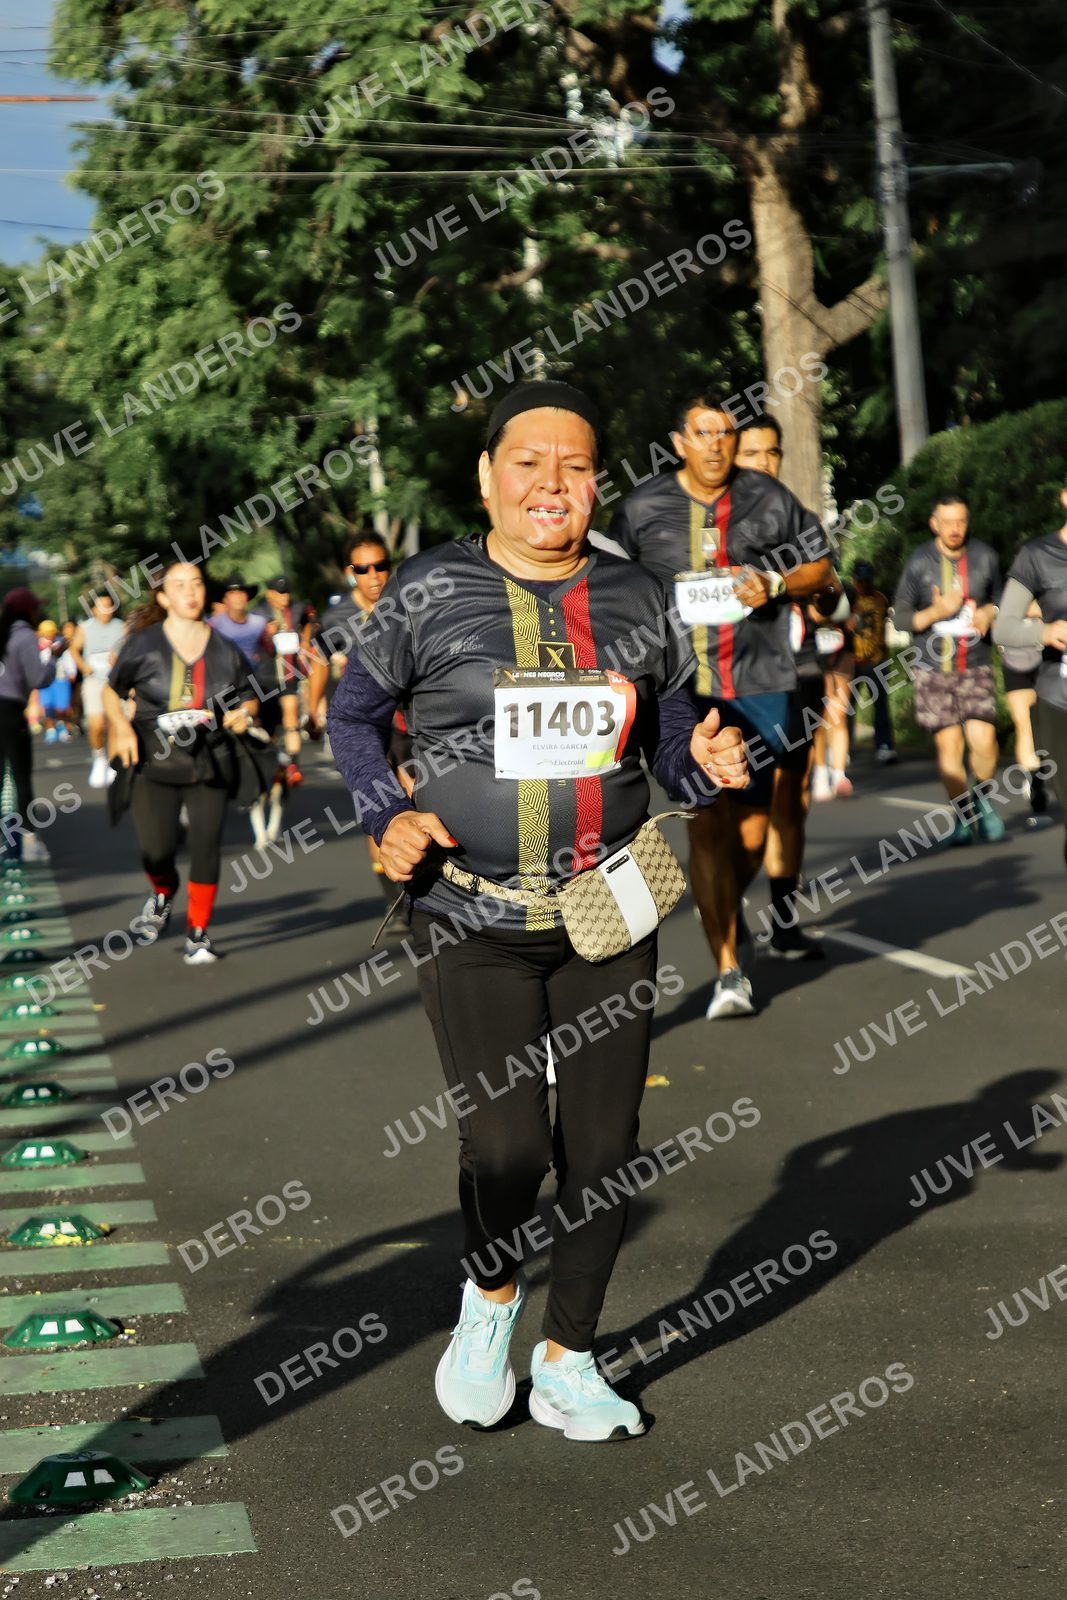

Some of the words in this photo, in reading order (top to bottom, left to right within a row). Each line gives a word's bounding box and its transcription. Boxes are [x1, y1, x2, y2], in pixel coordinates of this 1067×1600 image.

[687, 585, 731, 603] 9849
[503, 700, 616, 738] 11403
[532, 743, 559, 751] ELVIRA
